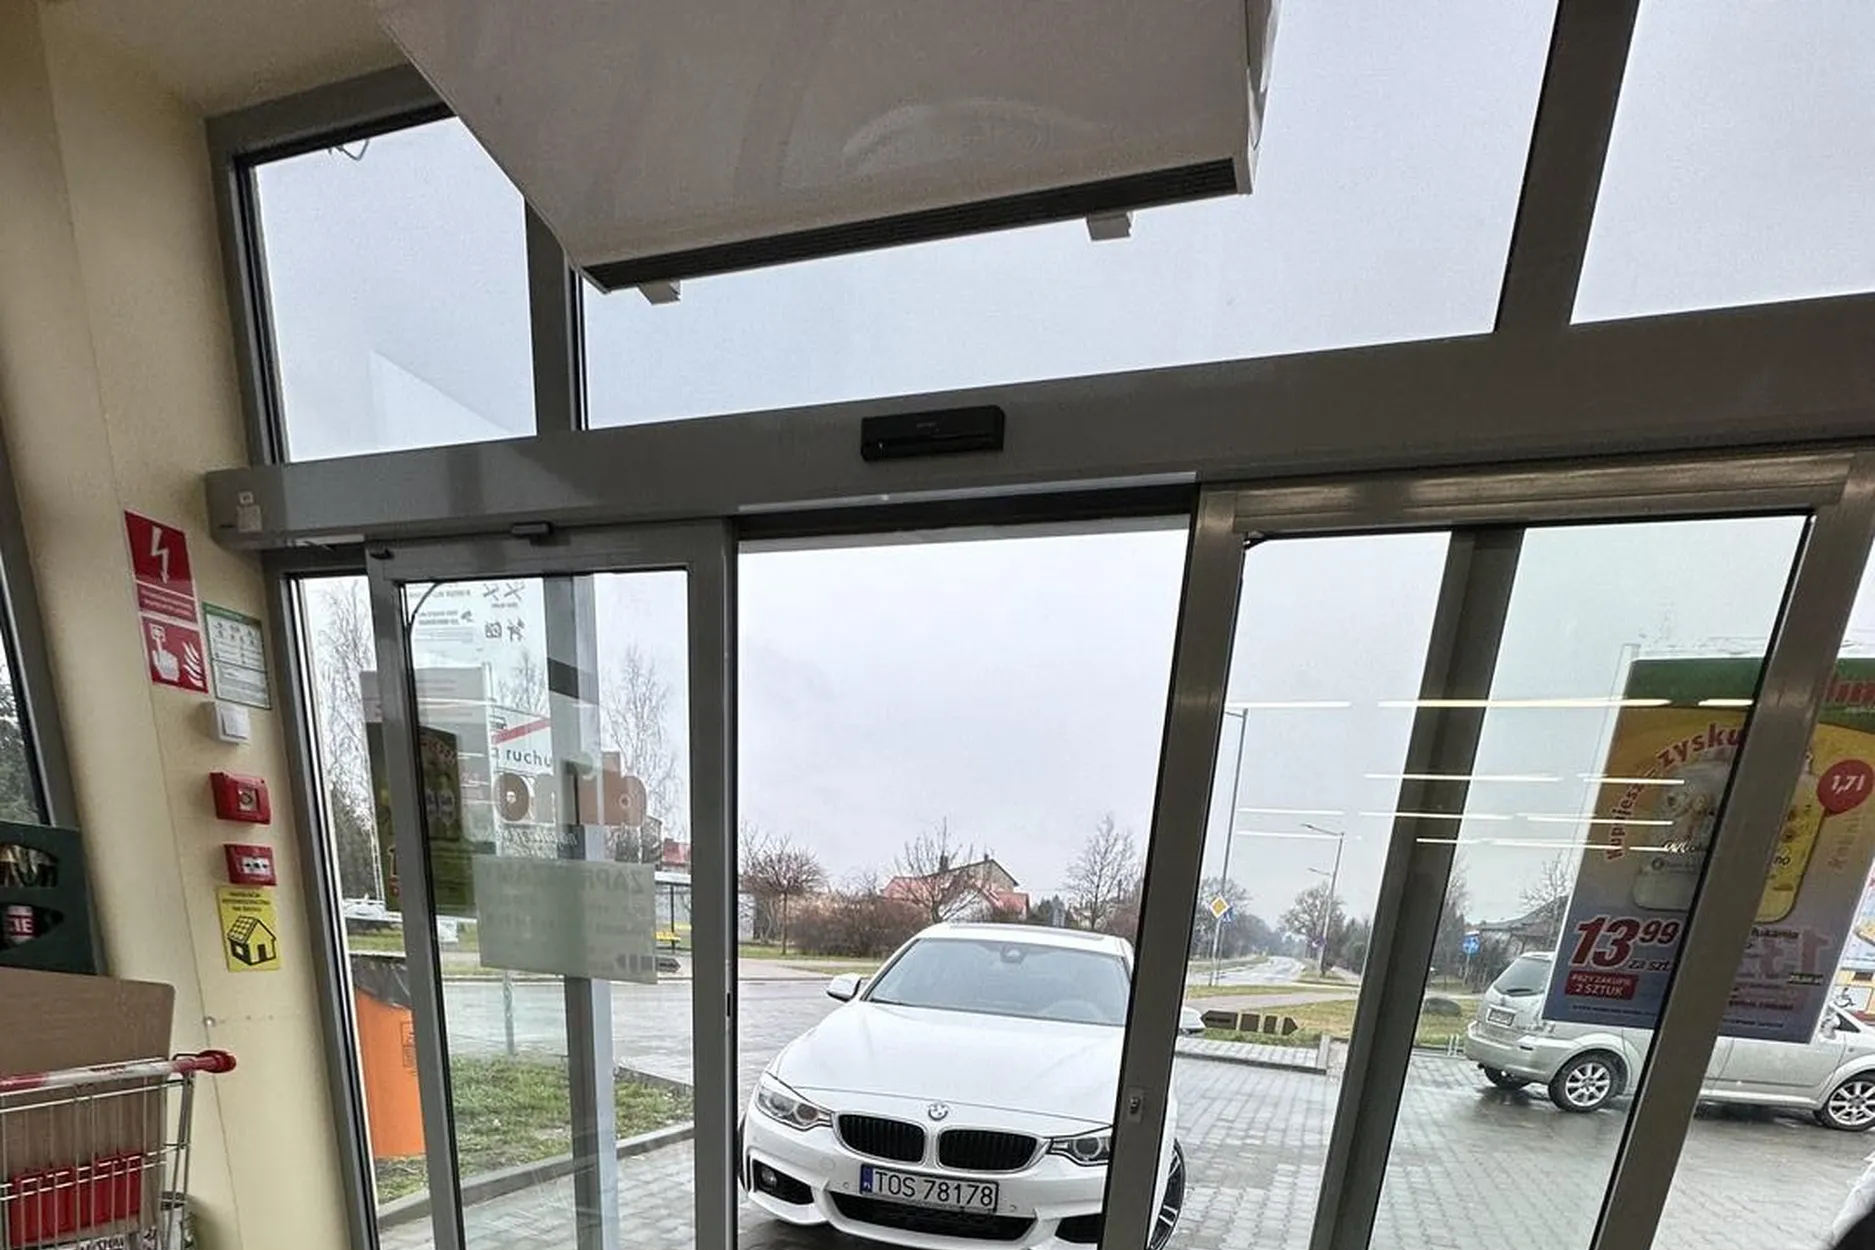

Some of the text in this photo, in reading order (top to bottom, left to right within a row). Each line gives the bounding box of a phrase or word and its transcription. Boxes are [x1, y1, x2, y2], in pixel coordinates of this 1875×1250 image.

[1657, 722, 1746, 766] zysku
[1570, 916, 1680, 969] 13 99
[1575, 983, 1623, 996] 2 SZTUK
[875, 1171, 993, 1206] TOS 78178
